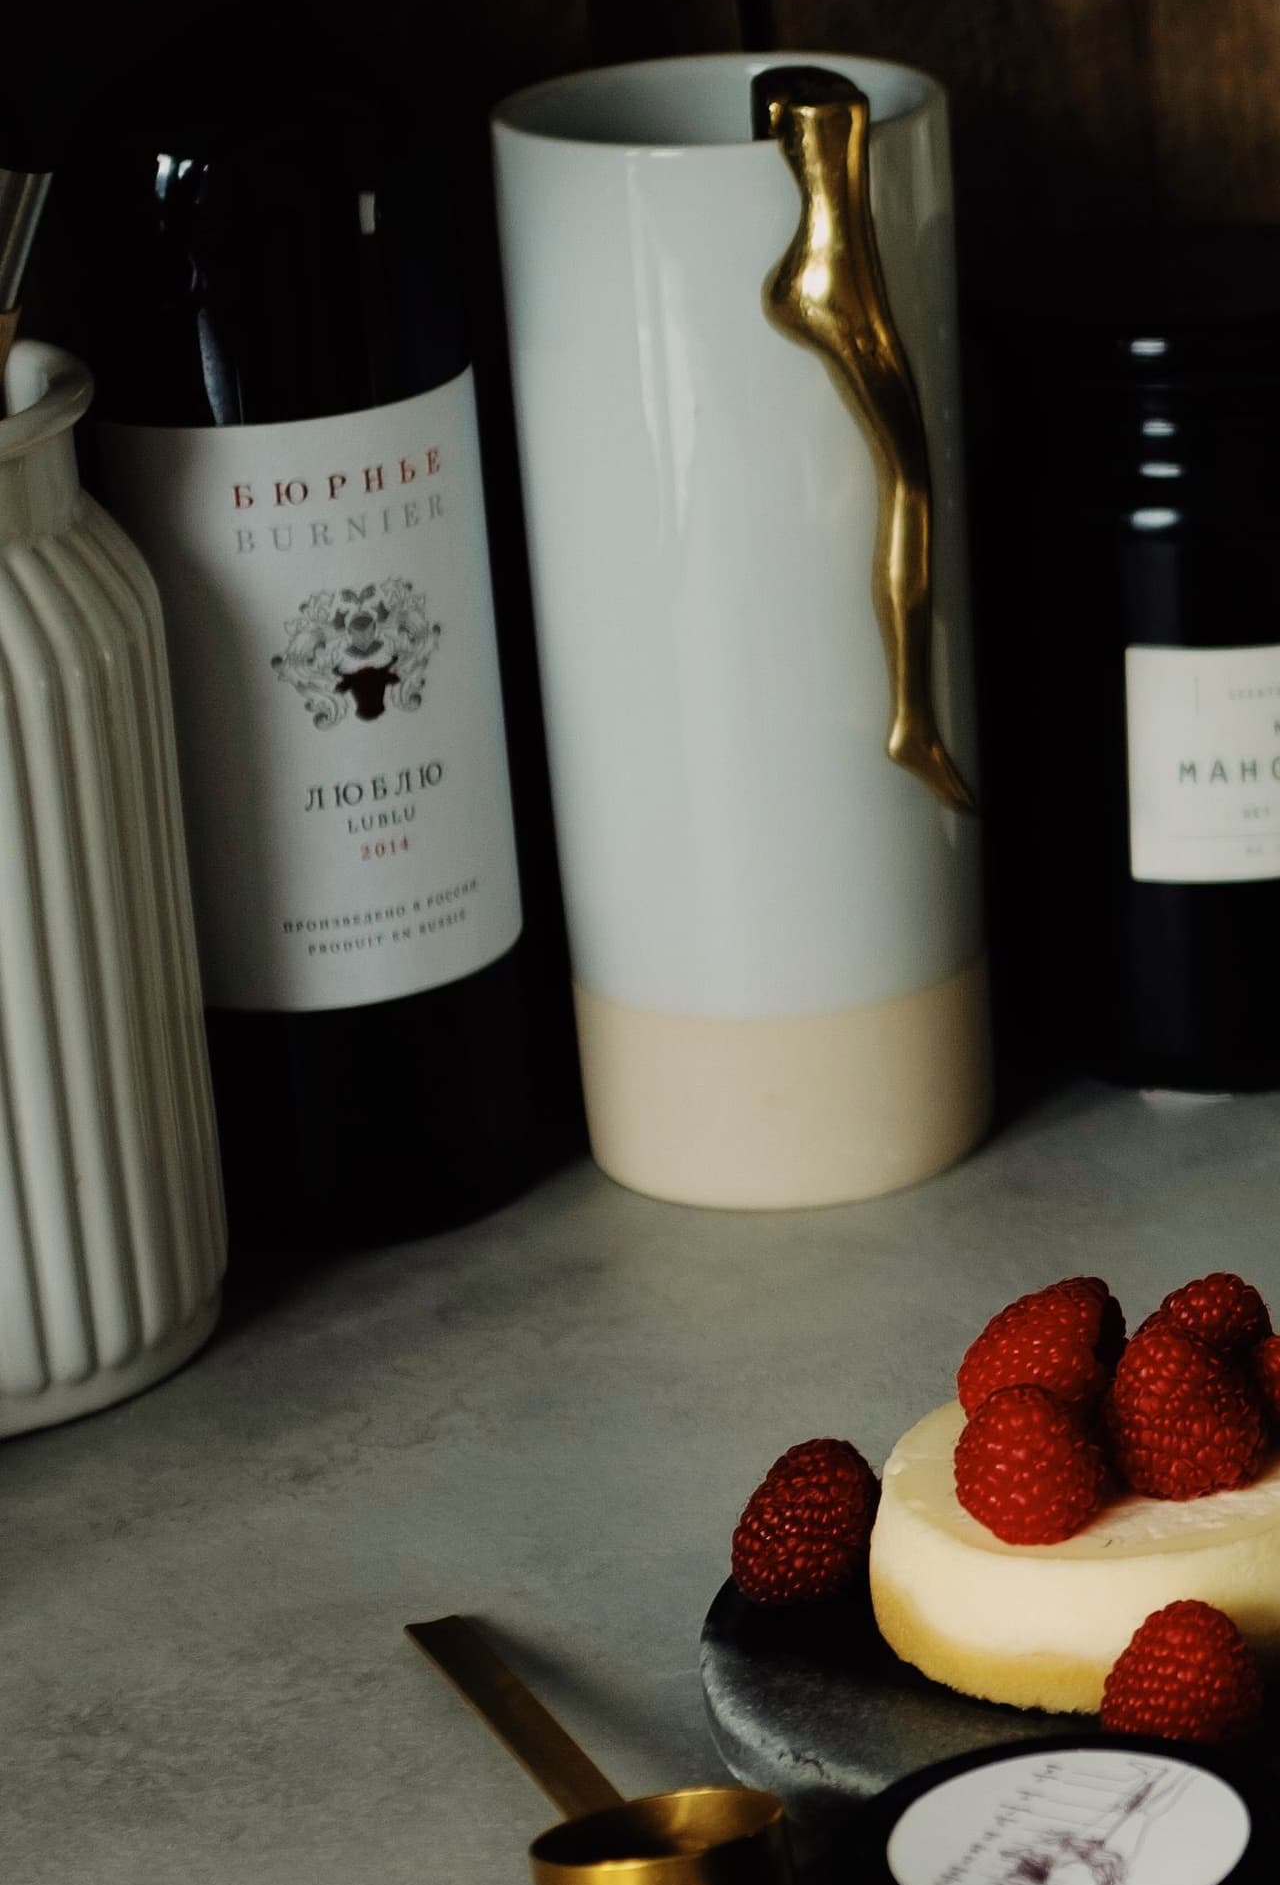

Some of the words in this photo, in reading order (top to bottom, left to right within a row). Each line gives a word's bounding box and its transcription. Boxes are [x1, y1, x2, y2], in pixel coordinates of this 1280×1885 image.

[232, 447, 441, 510] БЮРНЬЕ
[233, 494, 445, 554] BURNIER
[304, 761, 443, 812] ЛЮБЛЮ
[347, 804, 416, 834] LUBLU
